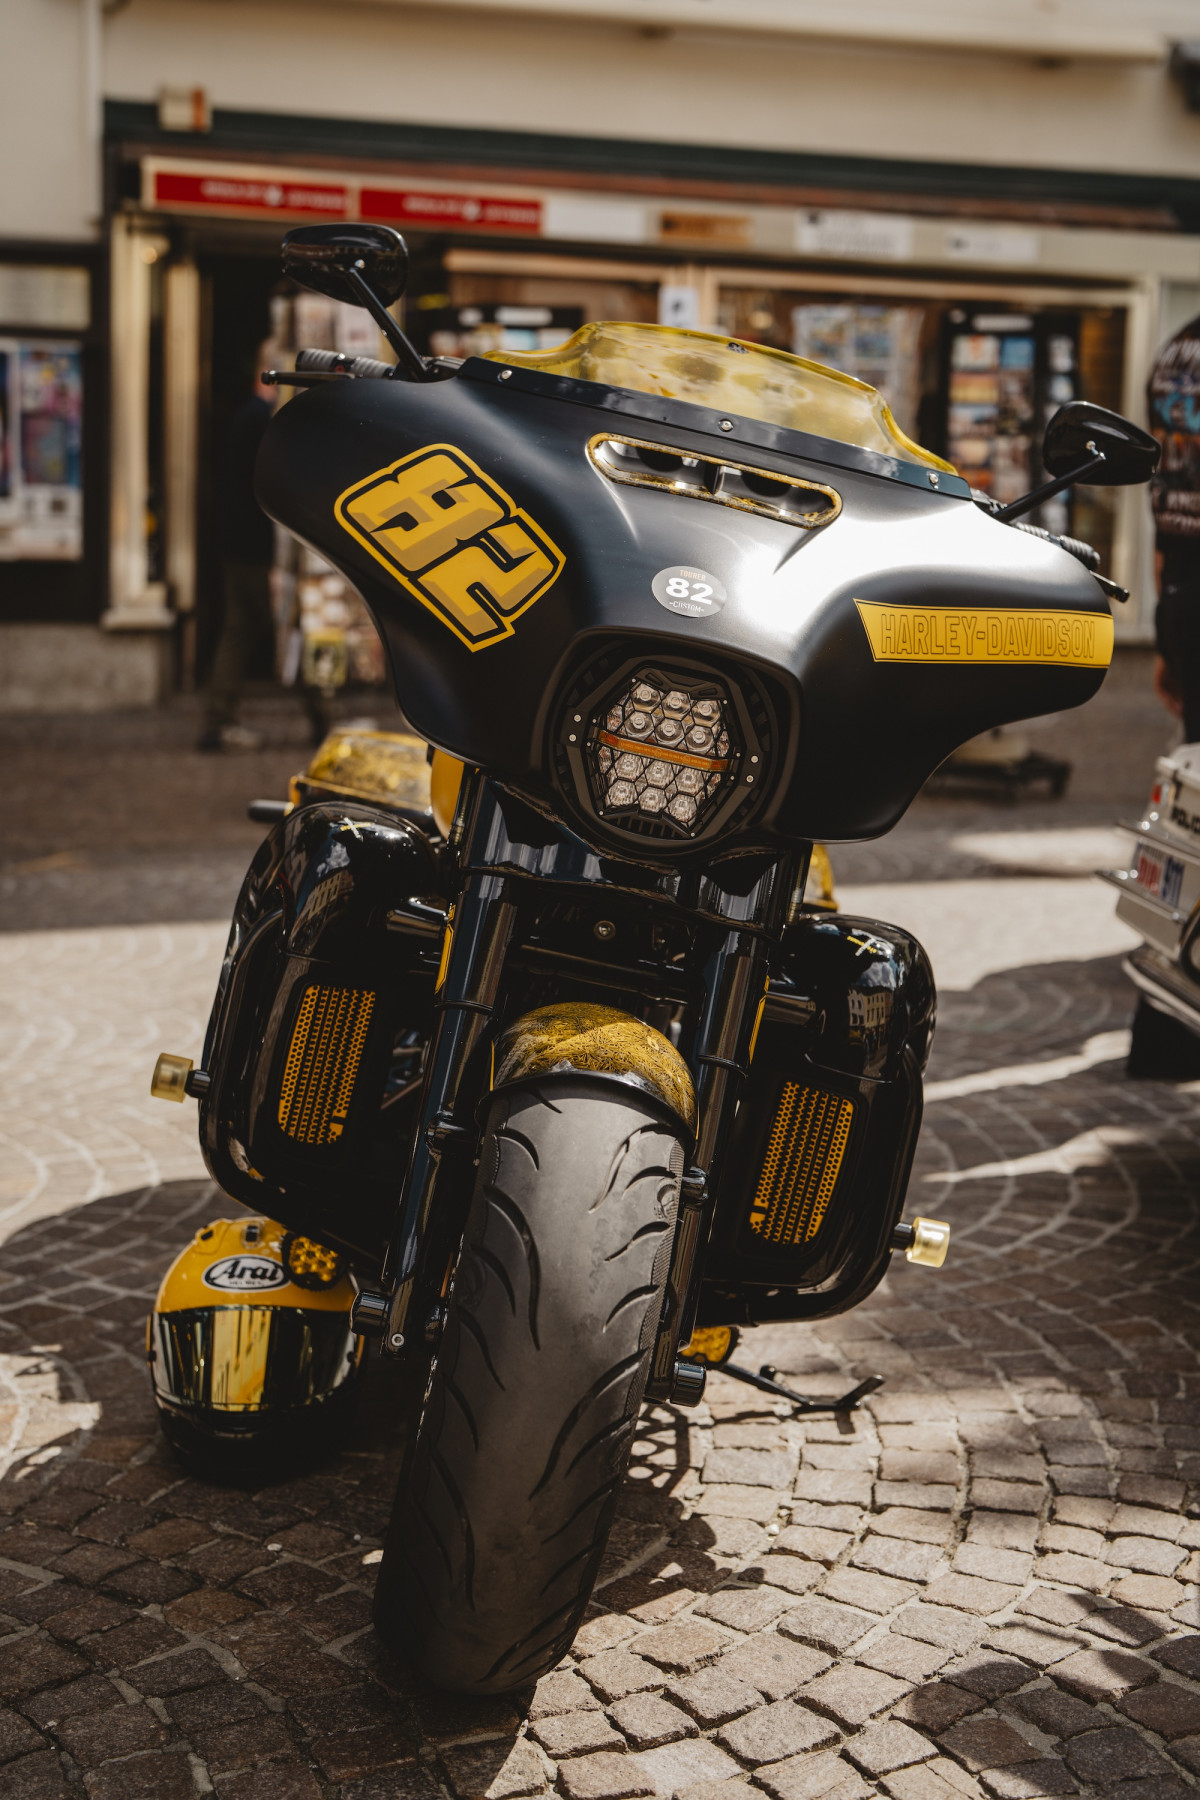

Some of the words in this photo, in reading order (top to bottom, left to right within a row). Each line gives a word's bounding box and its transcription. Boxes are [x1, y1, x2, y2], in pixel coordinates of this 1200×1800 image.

[334, 443, 566, 652] 82
[680, 569, 706, 581] TOURER
[666, 578, 713, 605] 82
[881, 614, 1095, 659] HARLEY-DAVIDSON
[210, 1261, 280, 1280] Arai
